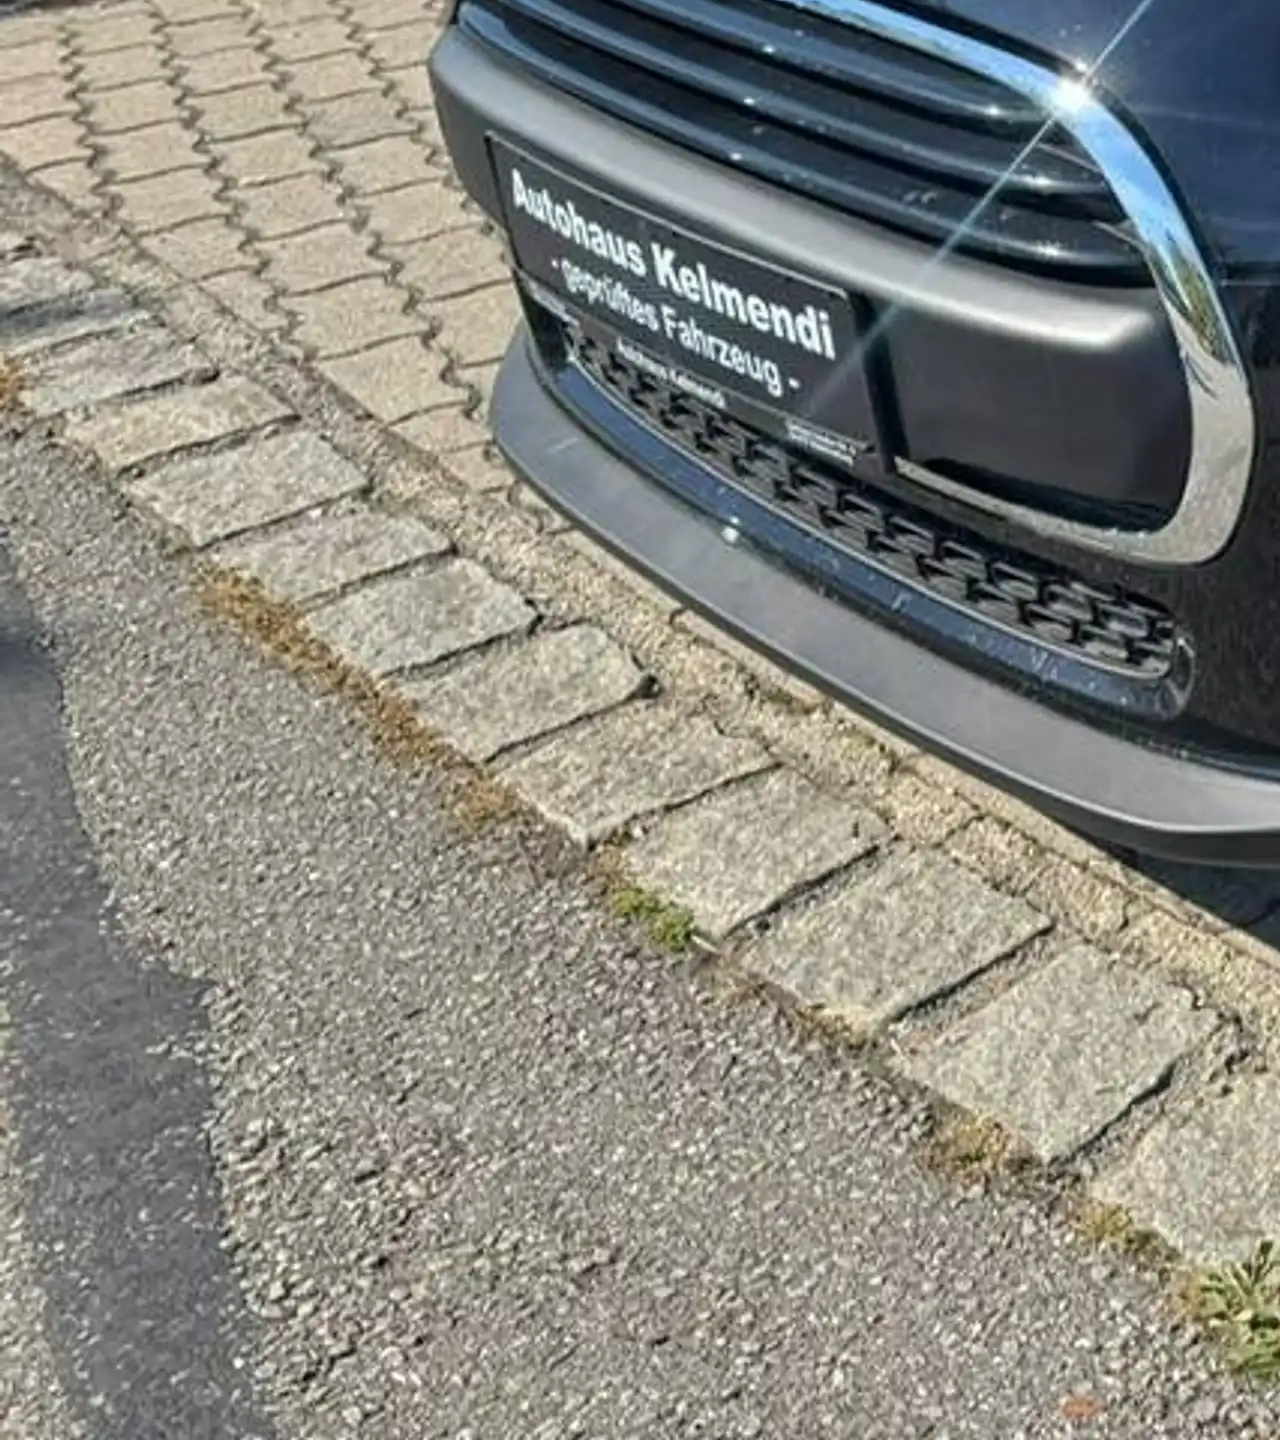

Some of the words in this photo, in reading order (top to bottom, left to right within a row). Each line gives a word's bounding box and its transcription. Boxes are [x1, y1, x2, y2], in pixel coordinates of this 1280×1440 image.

[512, 168, 647, 277] Autohaus
[651, 241, 836, 360] Kelmendi
[561, 257, 659, 331] geprüftes
[660, 303, 784, 398] Fahrzeug
